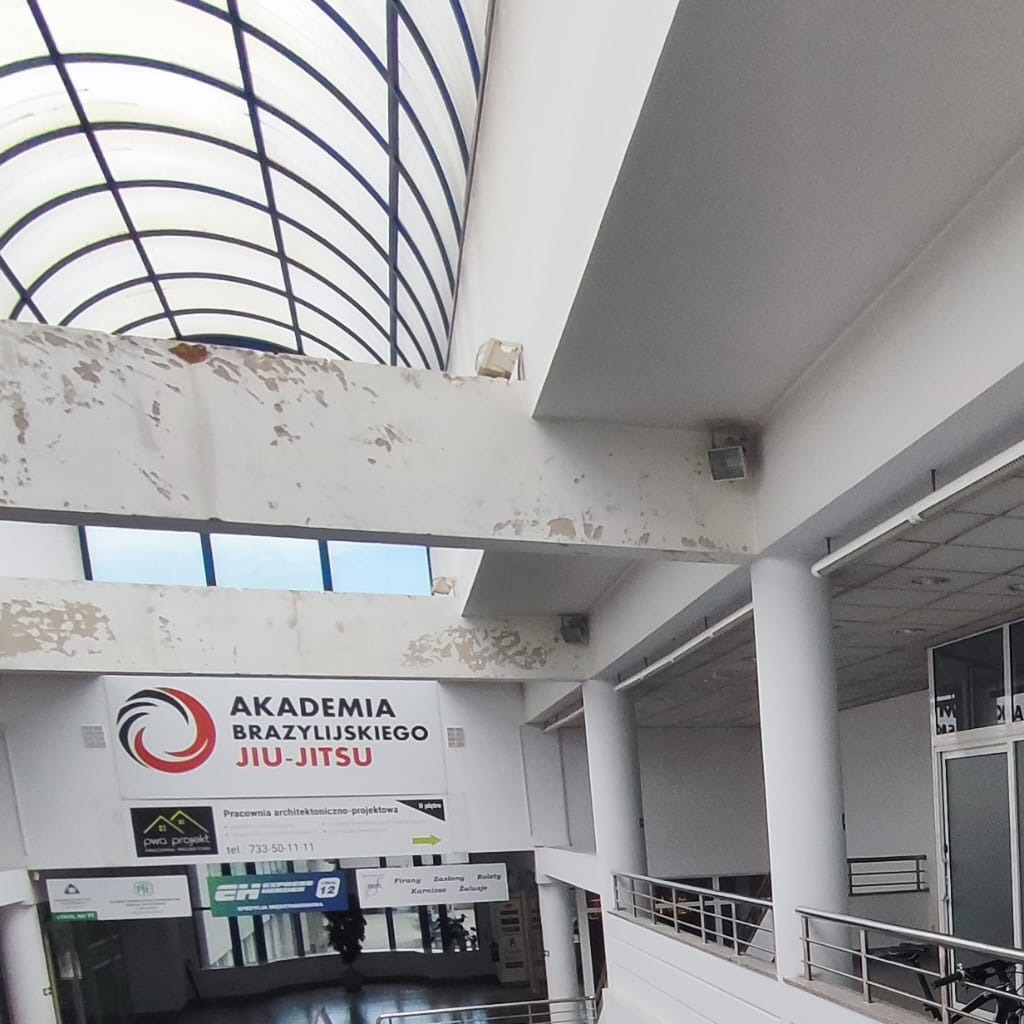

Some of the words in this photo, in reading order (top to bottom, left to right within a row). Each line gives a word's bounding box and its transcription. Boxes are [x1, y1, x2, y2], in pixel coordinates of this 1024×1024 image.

[230, 696, 396, 718] AKADEMIA
[232, 724, 429, 741] BRAZYLIJSKIEGO
[236, 747, 373, 767] JIU-JITSU
[223, 809, 272, 818] Pracownia
[274, 806, 399, 816] architektoniczno-projektowa
[143, 837, 168, 847] pwa
[171, 834, 211, 846] projekt
[248, 843, 314, 855] 733-50-11-11
[477, 873, 501, 881] Rolety
[320, 885, 336, 894] 12
